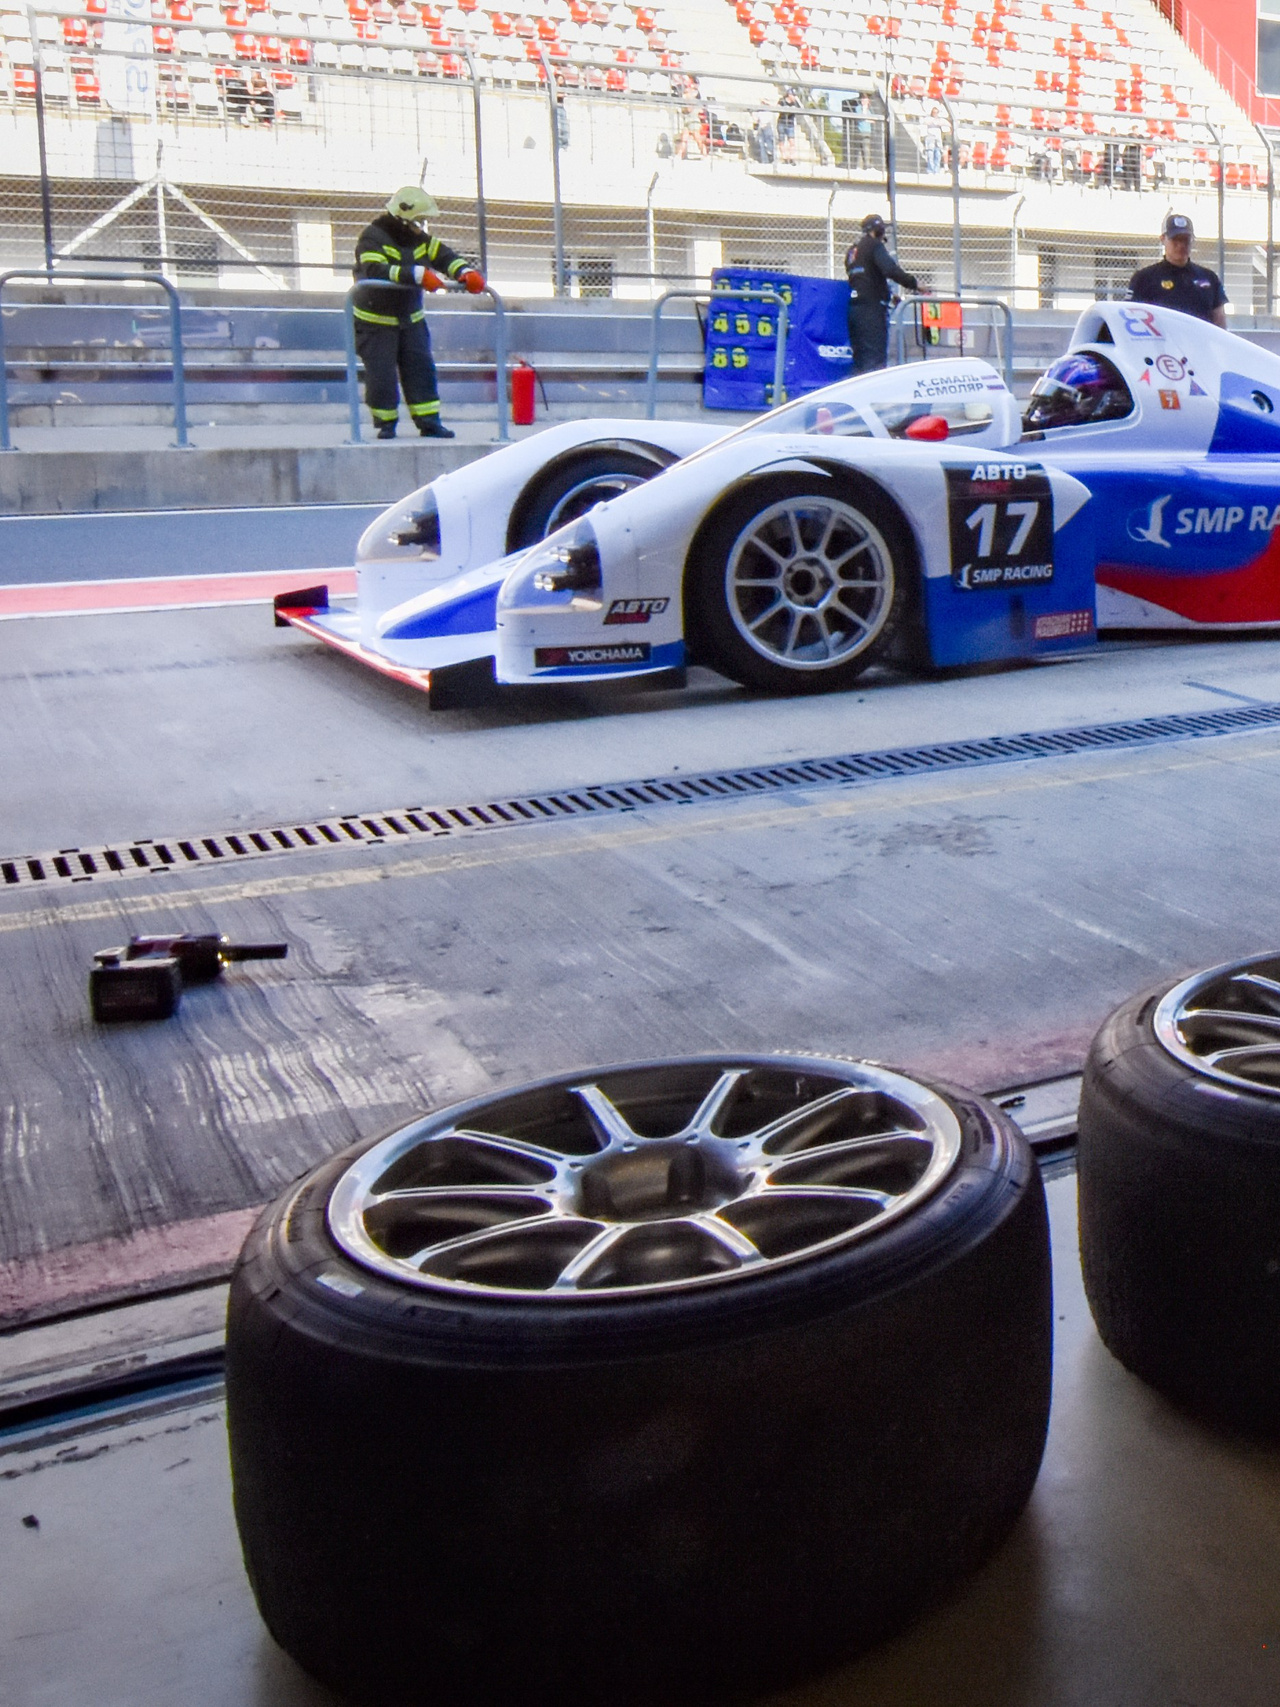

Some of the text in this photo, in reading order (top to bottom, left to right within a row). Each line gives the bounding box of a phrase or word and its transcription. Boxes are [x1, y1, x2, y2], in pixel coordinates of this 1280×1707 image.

[965, 501, 1039, 557] 17
[1175, 507, 1244, 534] SMP
[972, 564, 1053, 583] SMP RACING
[569, 648, 644, 662] YOKOHAMA
